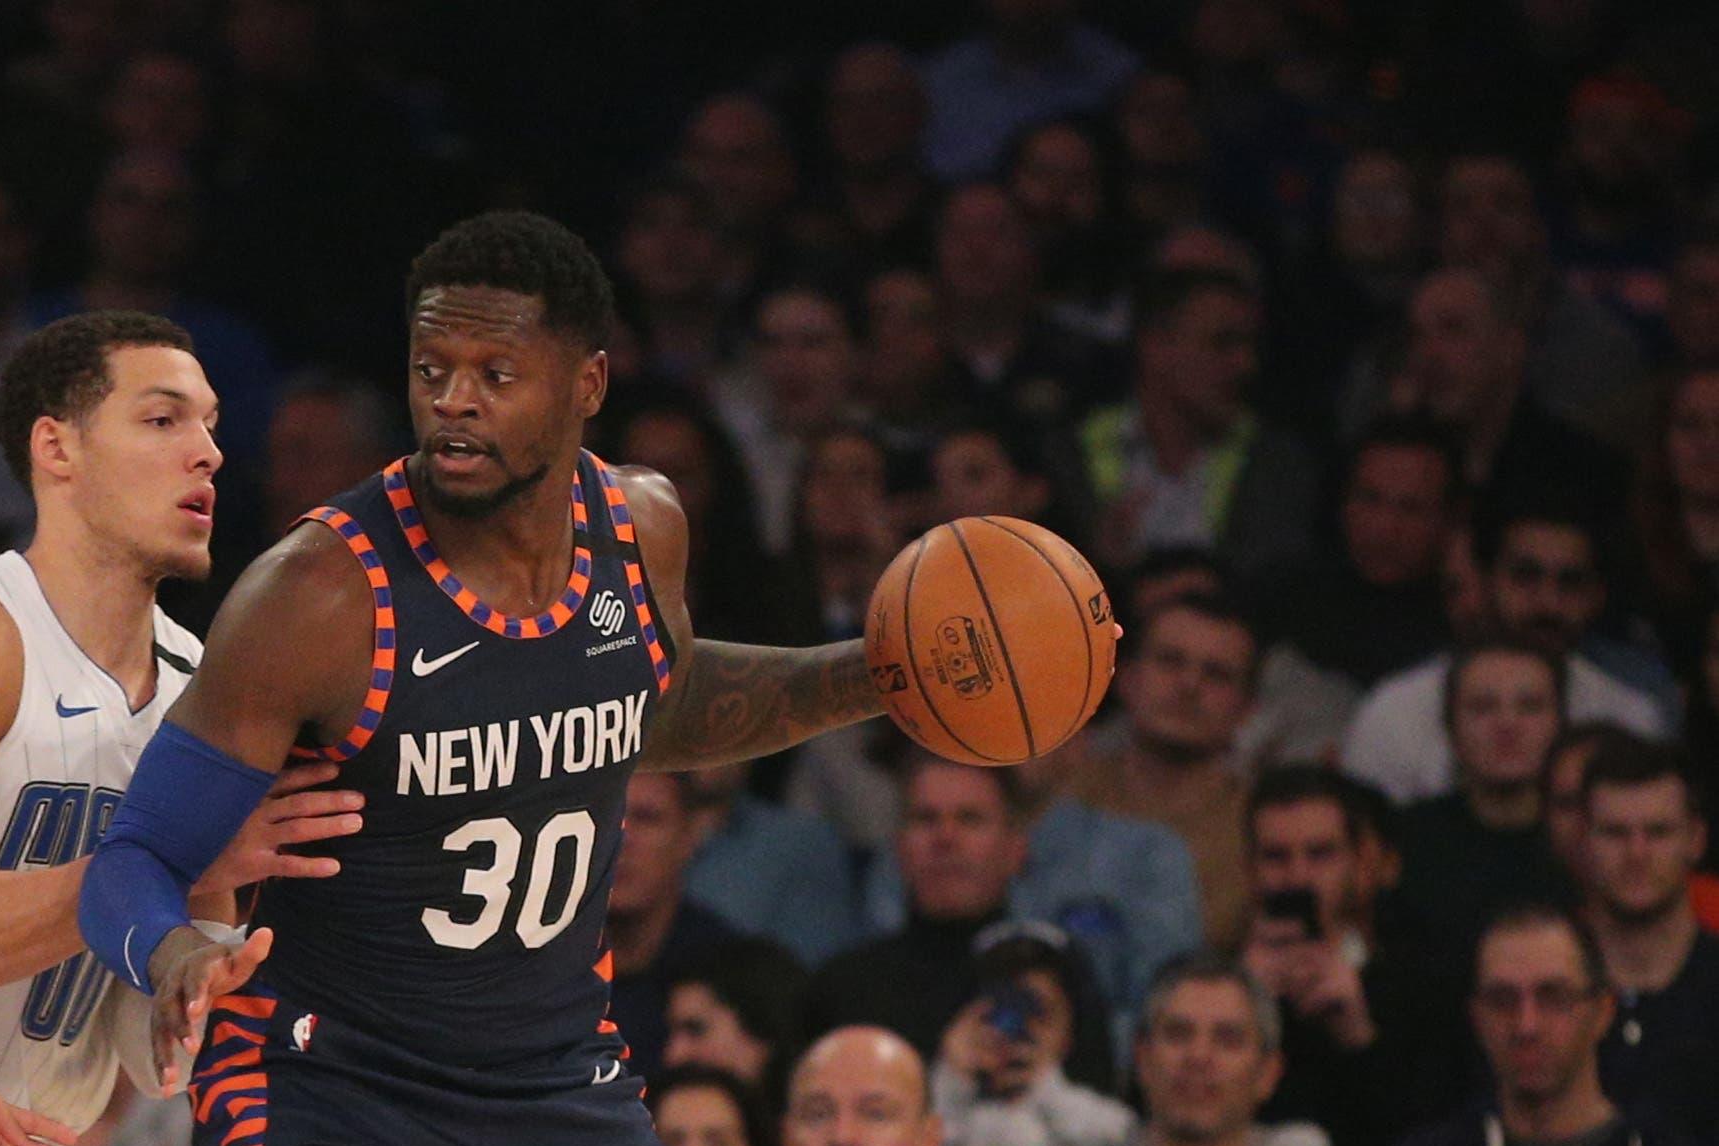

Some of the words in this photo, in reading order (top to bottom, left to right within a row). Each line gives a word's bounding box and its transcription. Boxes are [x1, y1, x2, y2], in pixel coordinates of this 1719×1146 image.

[585, 635, 637, 658] SQUARESPACE
[397, 719, 520, 796] NEW
[529, 689, 649, 780] YORK
[421, 810, 596, 950] 30
